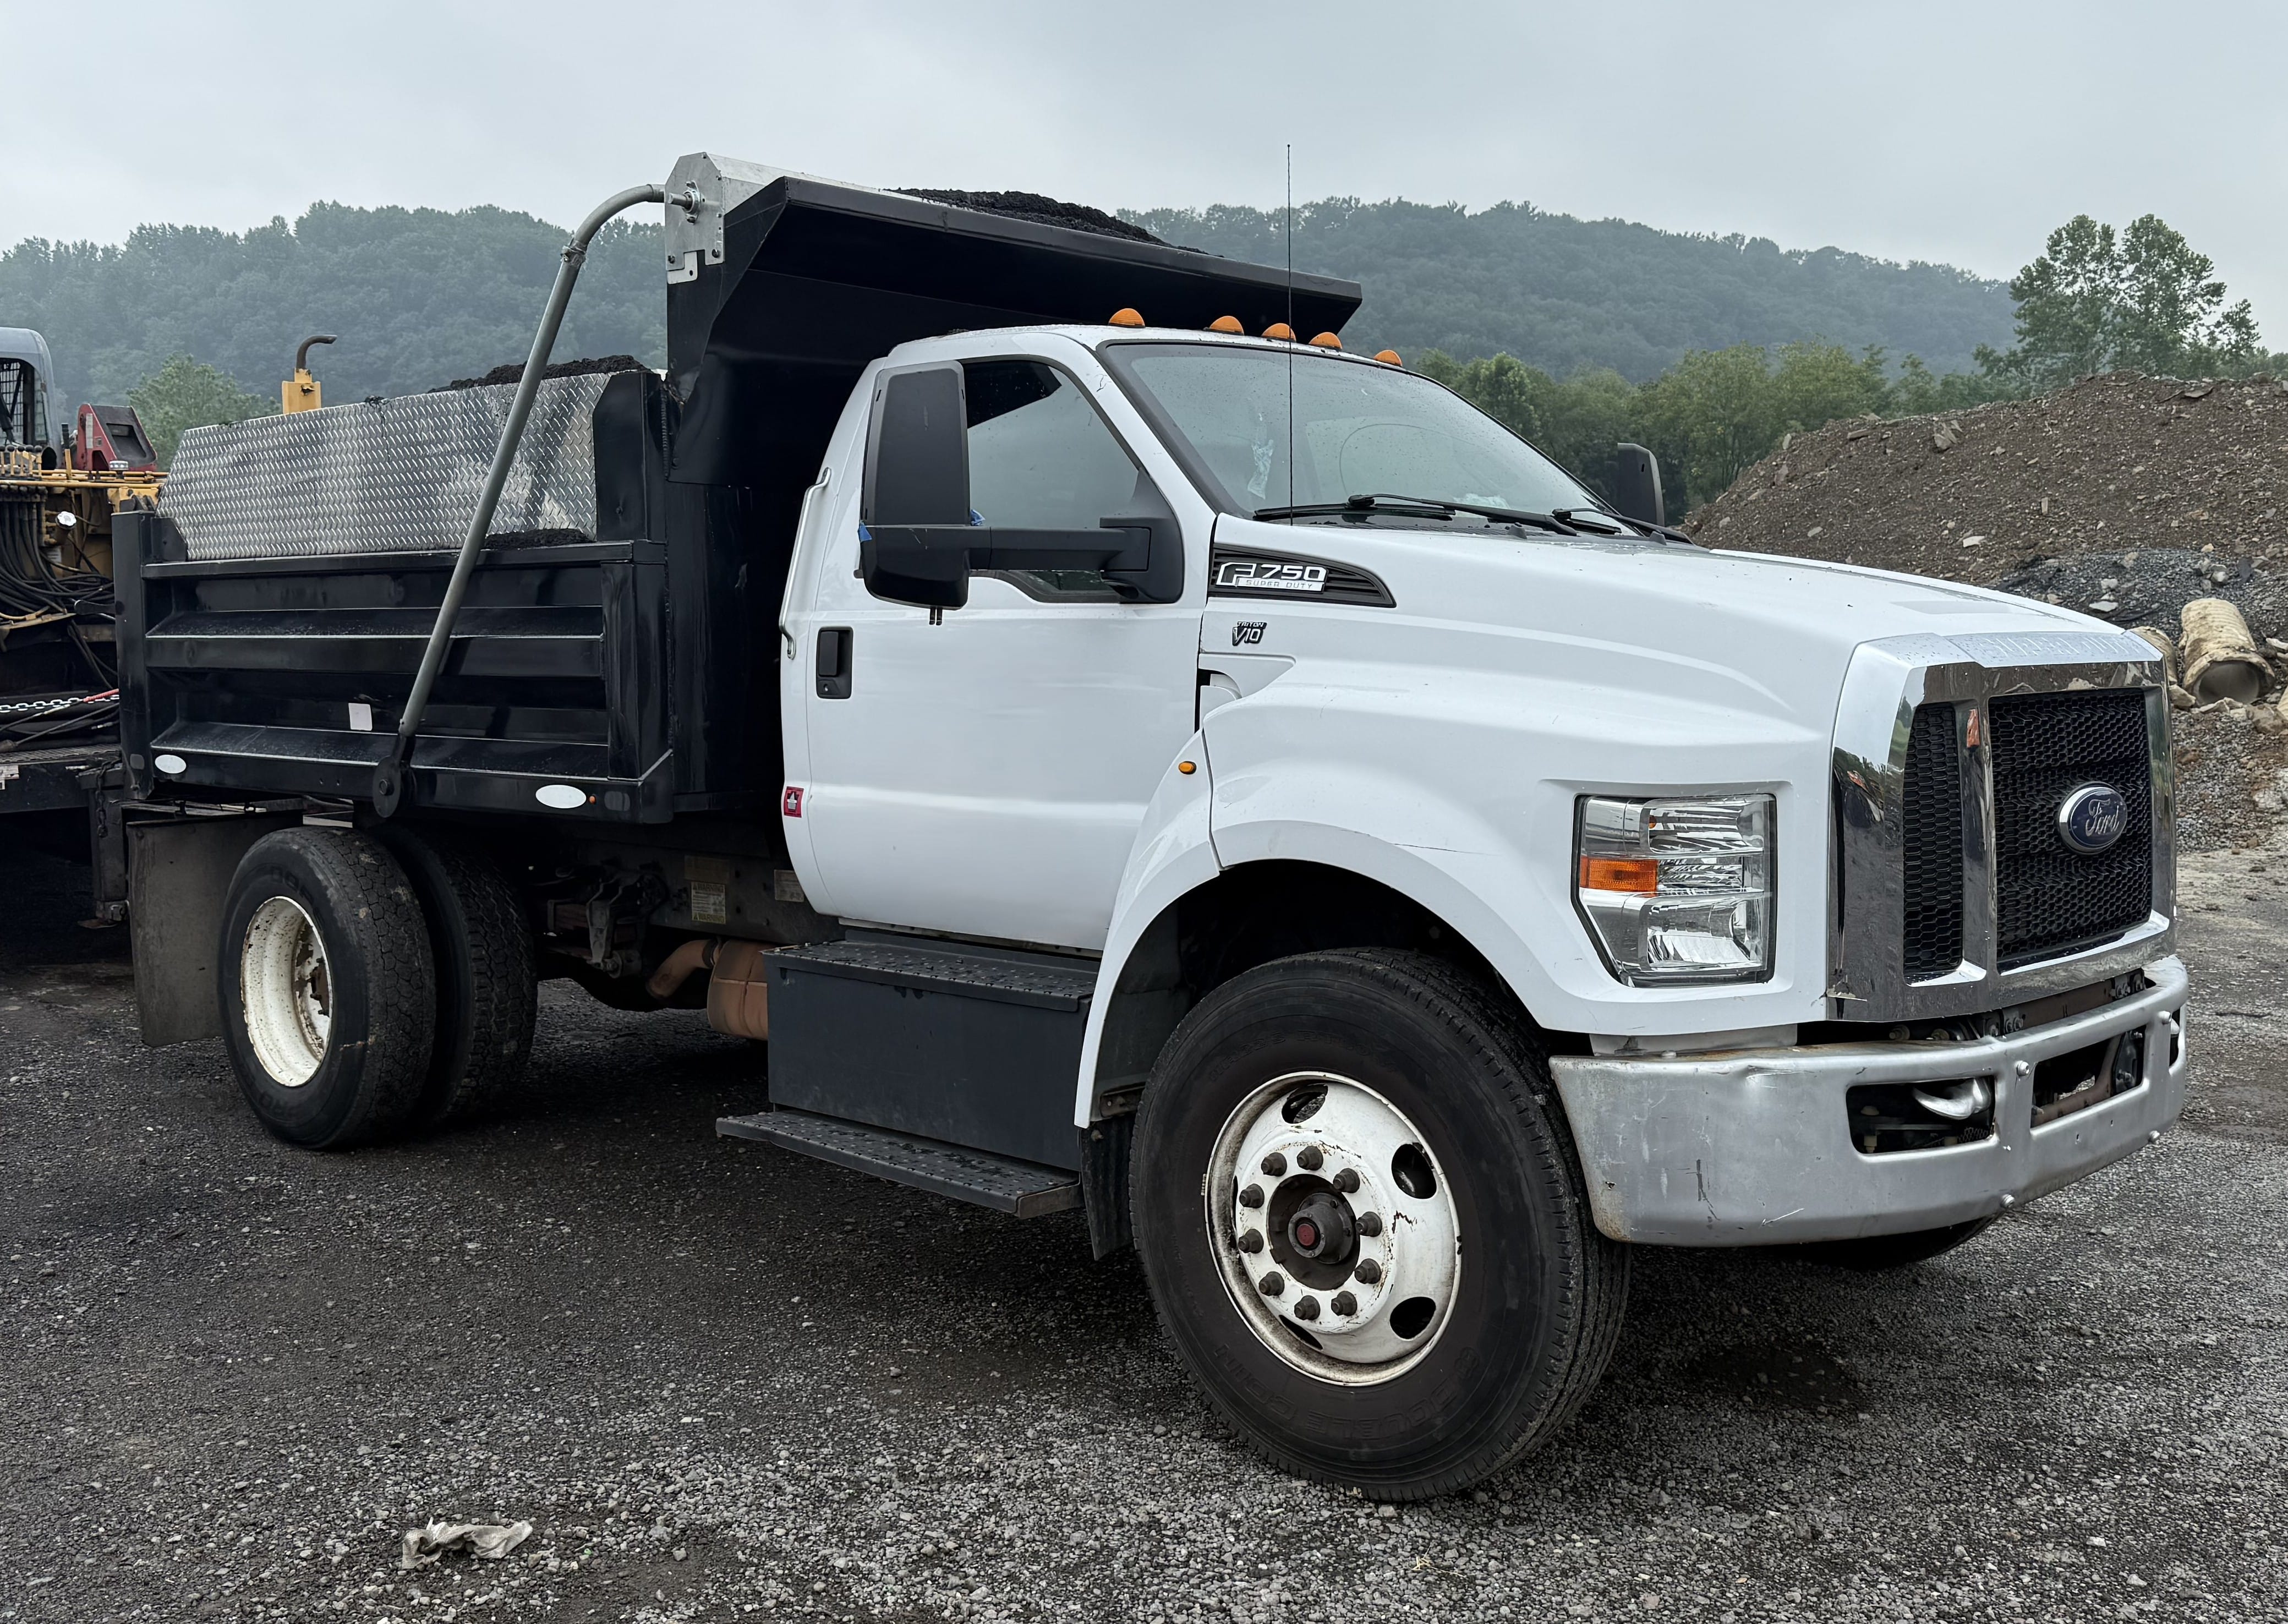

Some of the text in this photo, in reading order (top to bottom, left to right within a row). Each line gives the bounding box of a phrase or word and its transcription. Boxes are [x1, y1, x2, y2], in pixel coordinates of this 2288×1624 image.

[1233, 627, 1261, 645] V10
[2086, 799, 2120, 836] Ford
[1212, 1342, 1460, 1441] DOUBLE COIN
